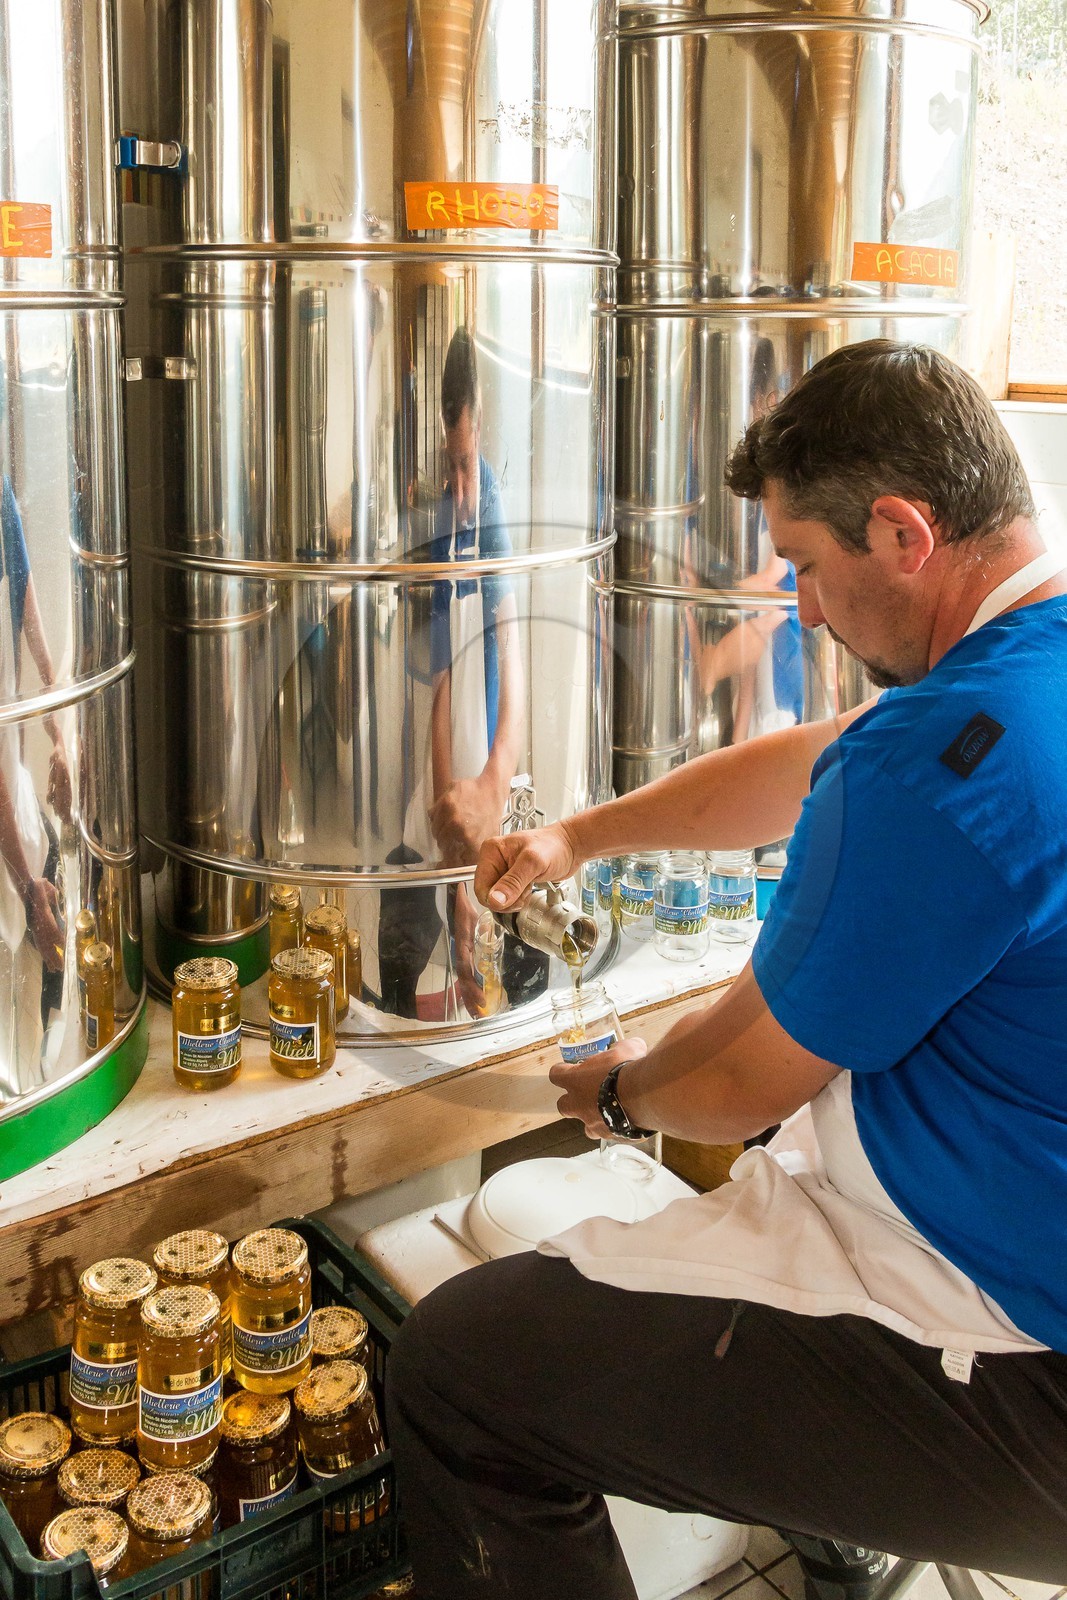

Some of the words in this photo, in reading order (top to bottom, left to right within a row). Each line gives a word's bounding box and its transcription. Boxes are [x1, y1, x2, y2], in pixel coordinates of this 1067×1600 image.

[426, 189, 544, 223] RHODO
[876, 249, 954, 283] ACACIA
[142, 1393, 181, 1410] Miellerie
